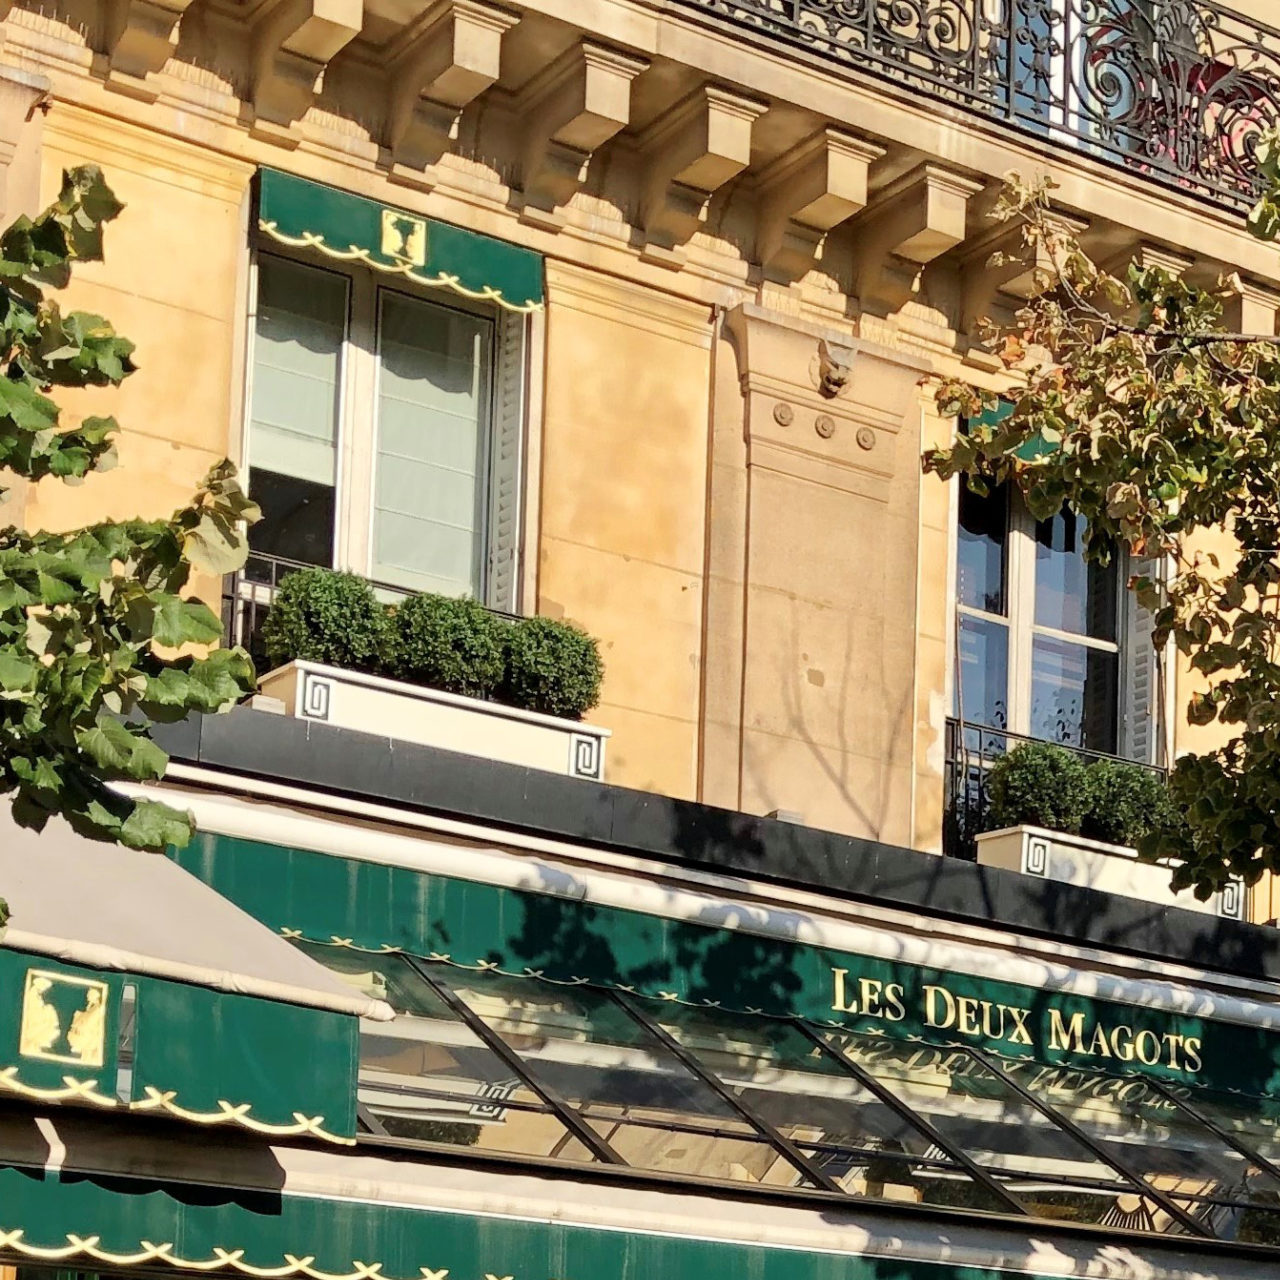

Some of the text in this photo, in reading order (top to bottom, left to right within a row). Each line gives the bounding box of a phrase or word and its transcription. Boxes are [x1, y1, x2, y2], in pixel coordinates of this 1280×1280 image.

[831, 967, 1203, 1073] LES DEUX MAGOTS
